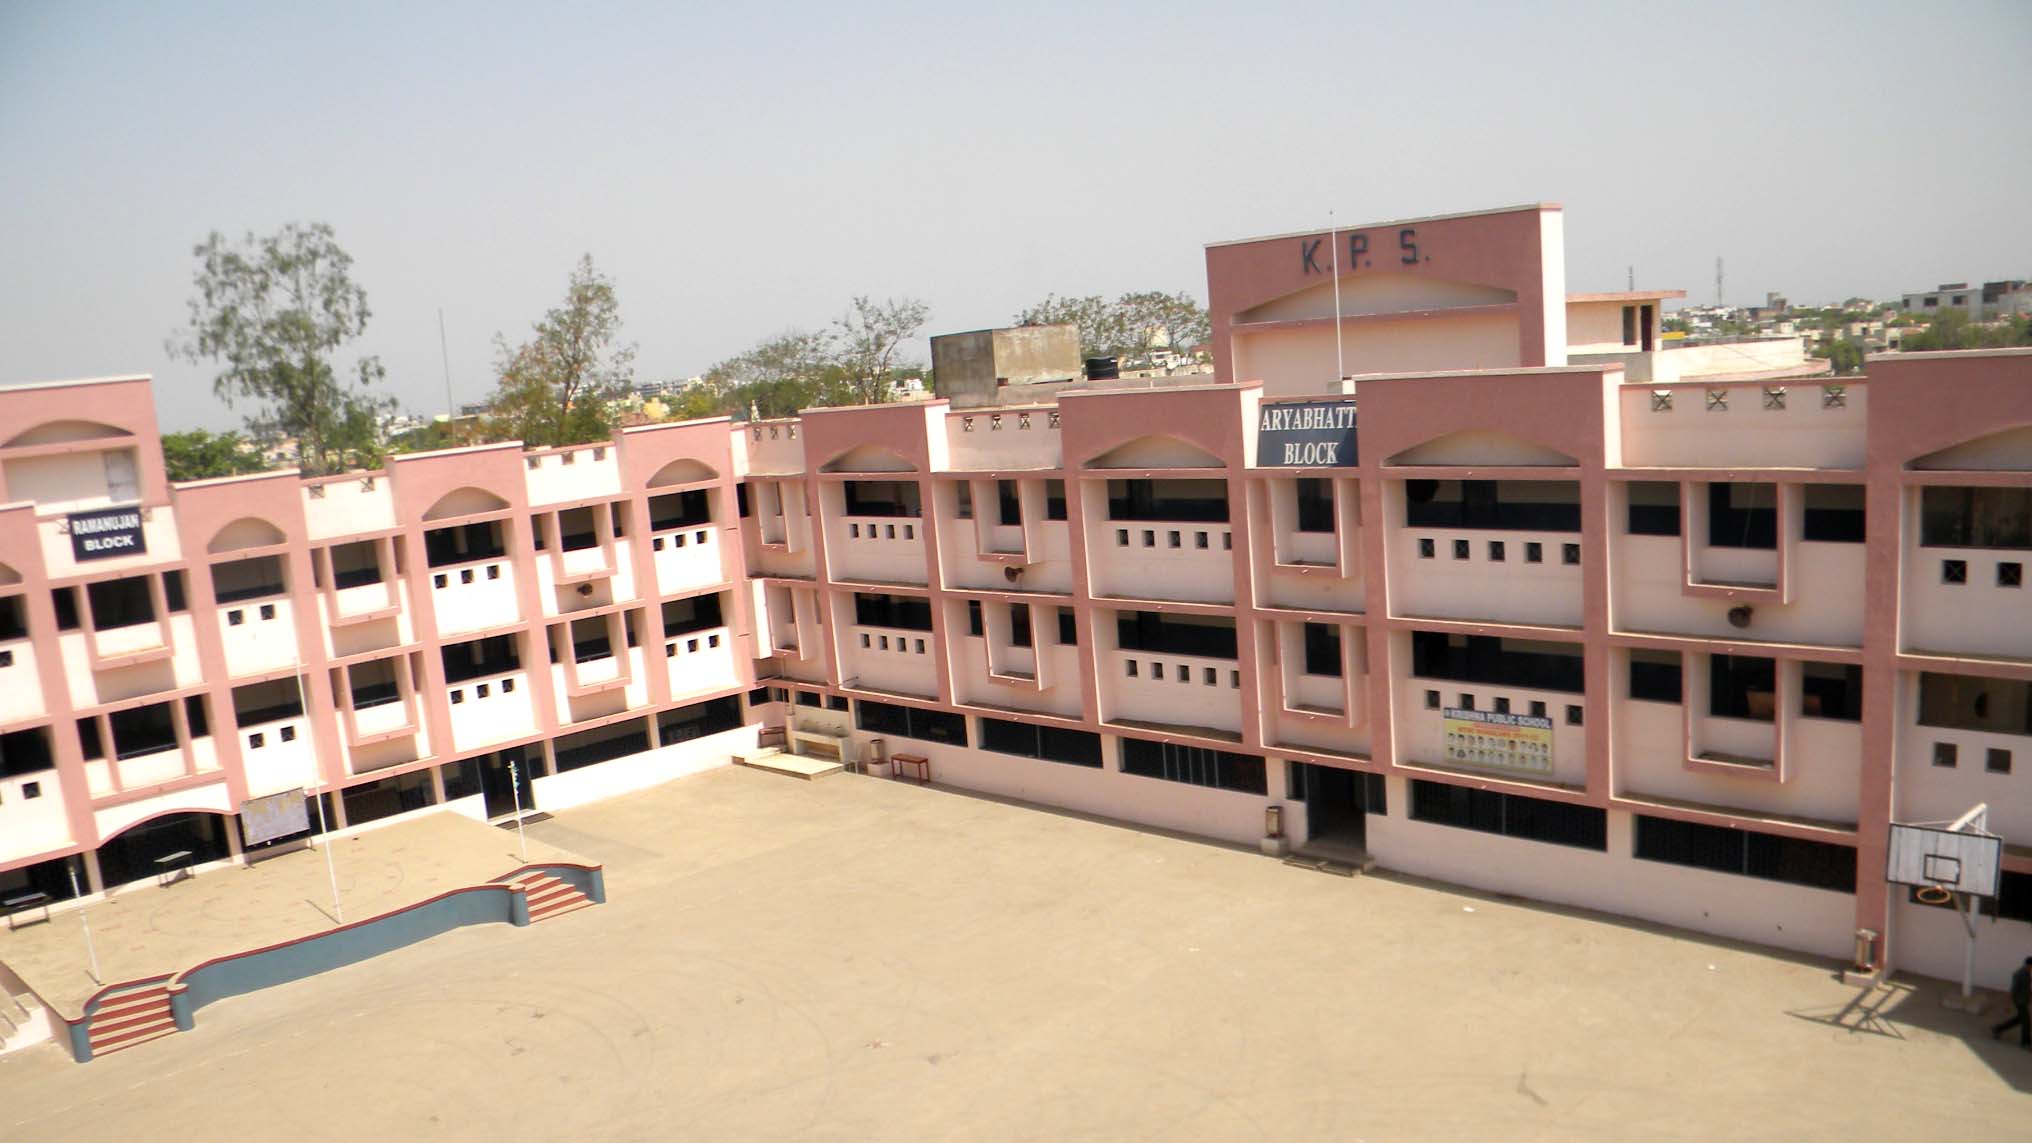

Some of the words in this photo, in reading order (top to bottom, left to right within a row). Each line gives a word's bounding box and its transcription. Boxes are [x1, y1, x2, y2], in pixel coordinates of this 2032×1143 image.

[1261, 406, 1358, 431] ARYABHATT
[1284, 442, 1339, 465] BLOCK
[72, 514, 139, 535] RAMANUJAN
[84, 535, 134, 551] BLOCK
[1487, 713, 1517, 725] PUBLIC
[1518, 716, 1551, 728] SCHOOL
